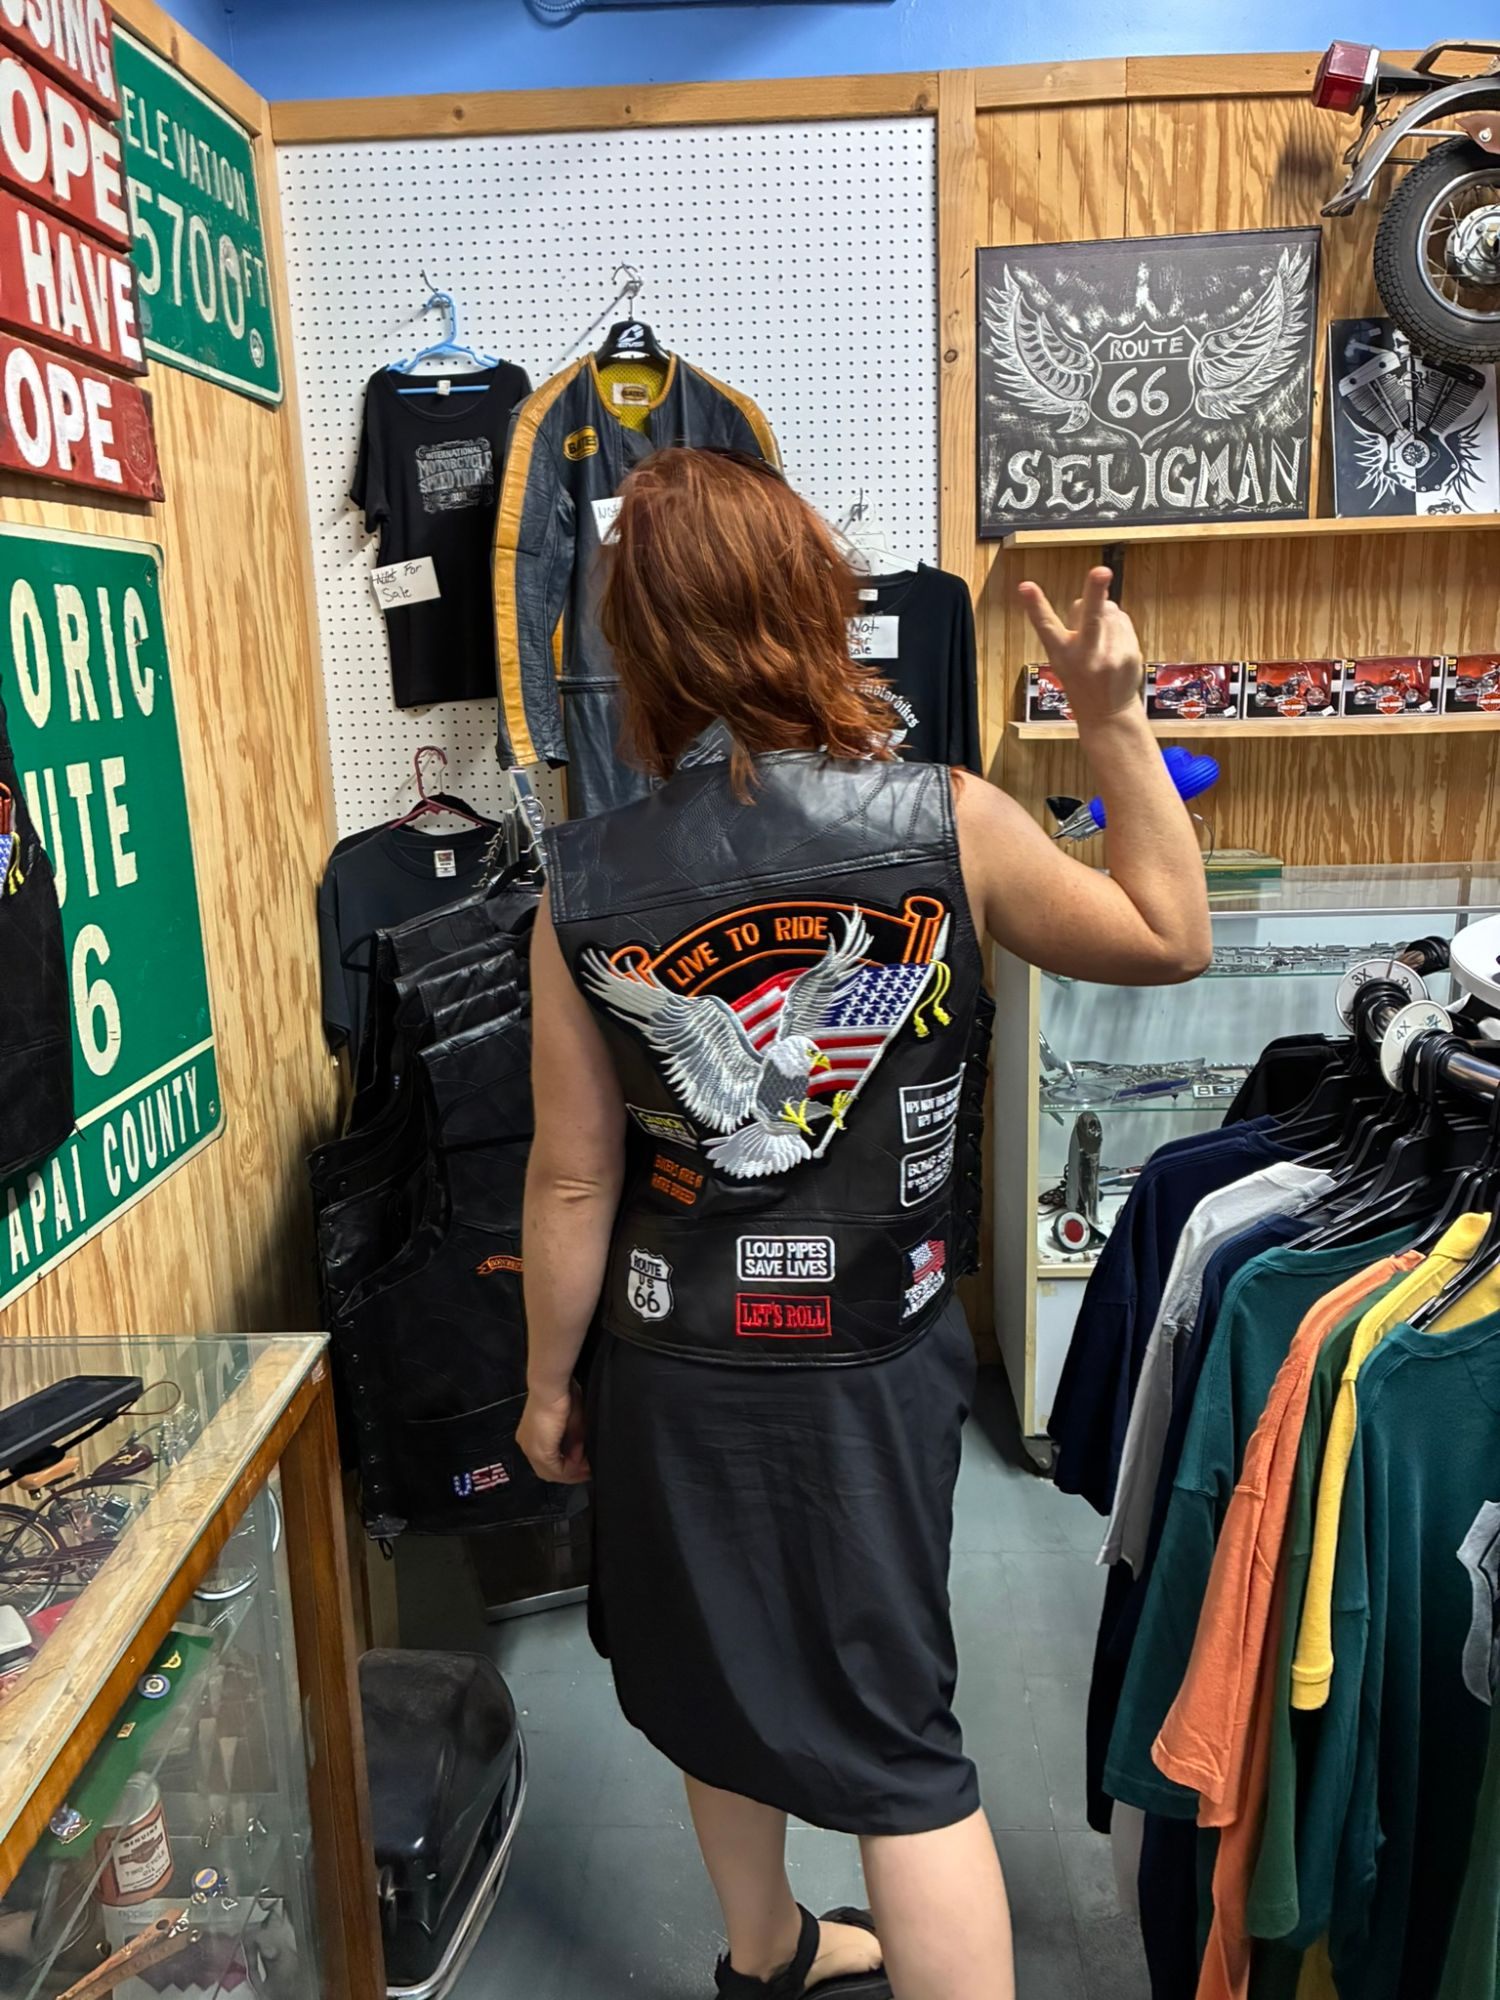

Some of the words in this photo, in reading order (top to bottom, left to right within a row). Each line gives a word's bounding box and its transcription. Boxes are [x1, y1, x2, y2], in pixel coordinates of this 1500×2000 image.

[1, 0, 117, 102] SING
[121, 84, 250, 222] ELEVATION
[126, 175, 245, 341] 5700
[242, 248, 267, 308] FT
[17, 210, 143, 364] HAVE
[1109, 335, 1185, 361] ROUTE
[1107, 366, 1170, 419] 66
[416, 450, 493, 480] MOTORCYCLE
[997, 436, 1308, 513] SELIGMAN
[403, 562, 422, 576] For
[382, 586, 412, 603] Sale
[850, 616, 880, 635] Not
[10, 578, 154, 729] ORIC
[667, 941, 720, 987] LIVE
[723, 922, 760, 952] TO
[773, 916, 829, 942] RIDE
[1351, 968, 1373, 987] 3X
[1395, 1020, 1412, 1041] 4X
[103, 1066, 200, 1197] COUNTY
[745, 1241, 784, 1258] LOUD
[786, 1242, 827, 1259] PIPES
[633, 1254, 662, 1277] ROUTE
[745, 1259, 783, 1276] SAVE
[786, 1260, 828, 1276] LIVES
[634, 1286, 661, 1313] 66
[741, 1301, 783, 1328] LET'S
[784, 1304, 826, 1329] ROLL
[453, 1462, 511, 1497] USA
